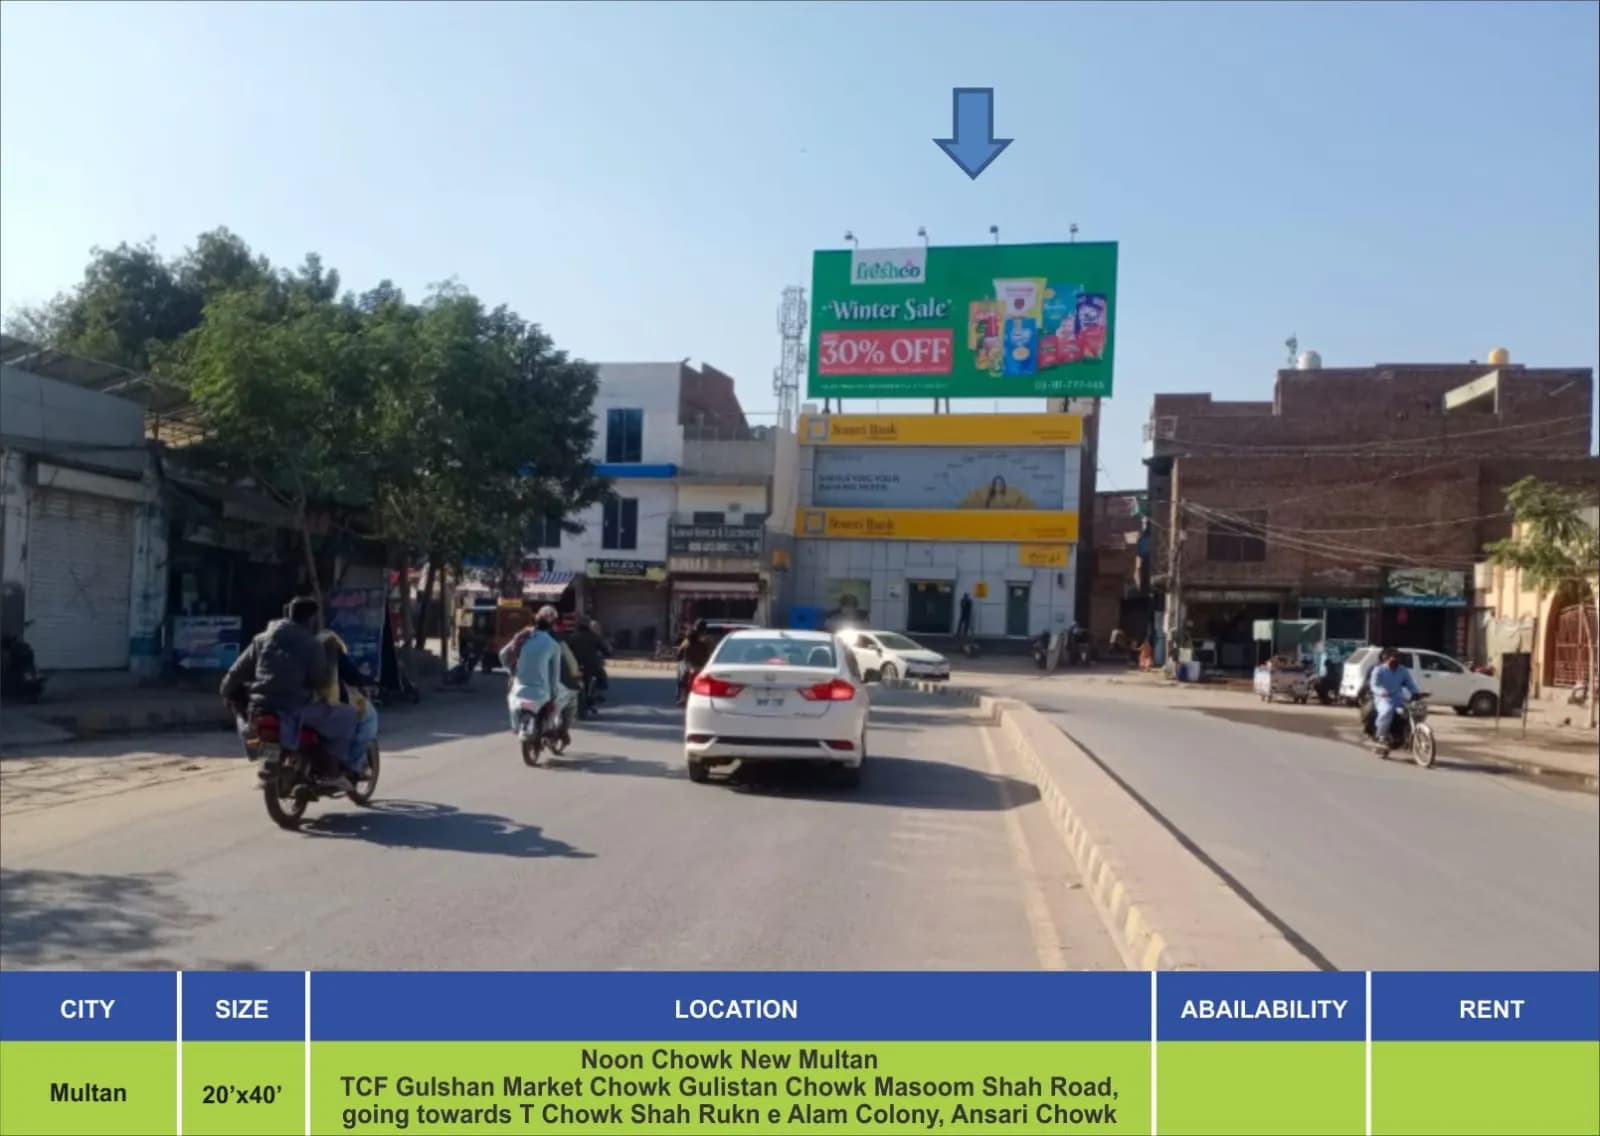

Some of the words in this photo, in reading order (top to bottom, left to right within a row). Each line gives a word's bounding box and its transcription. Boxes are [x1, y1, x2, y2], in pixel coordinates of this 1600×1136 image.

[832, 300, 899, 320] Winter
[903, 297, 946, 320] Sale
[821, 338, 885, 365] 30%
[890, 337, 950, 364] OFF
